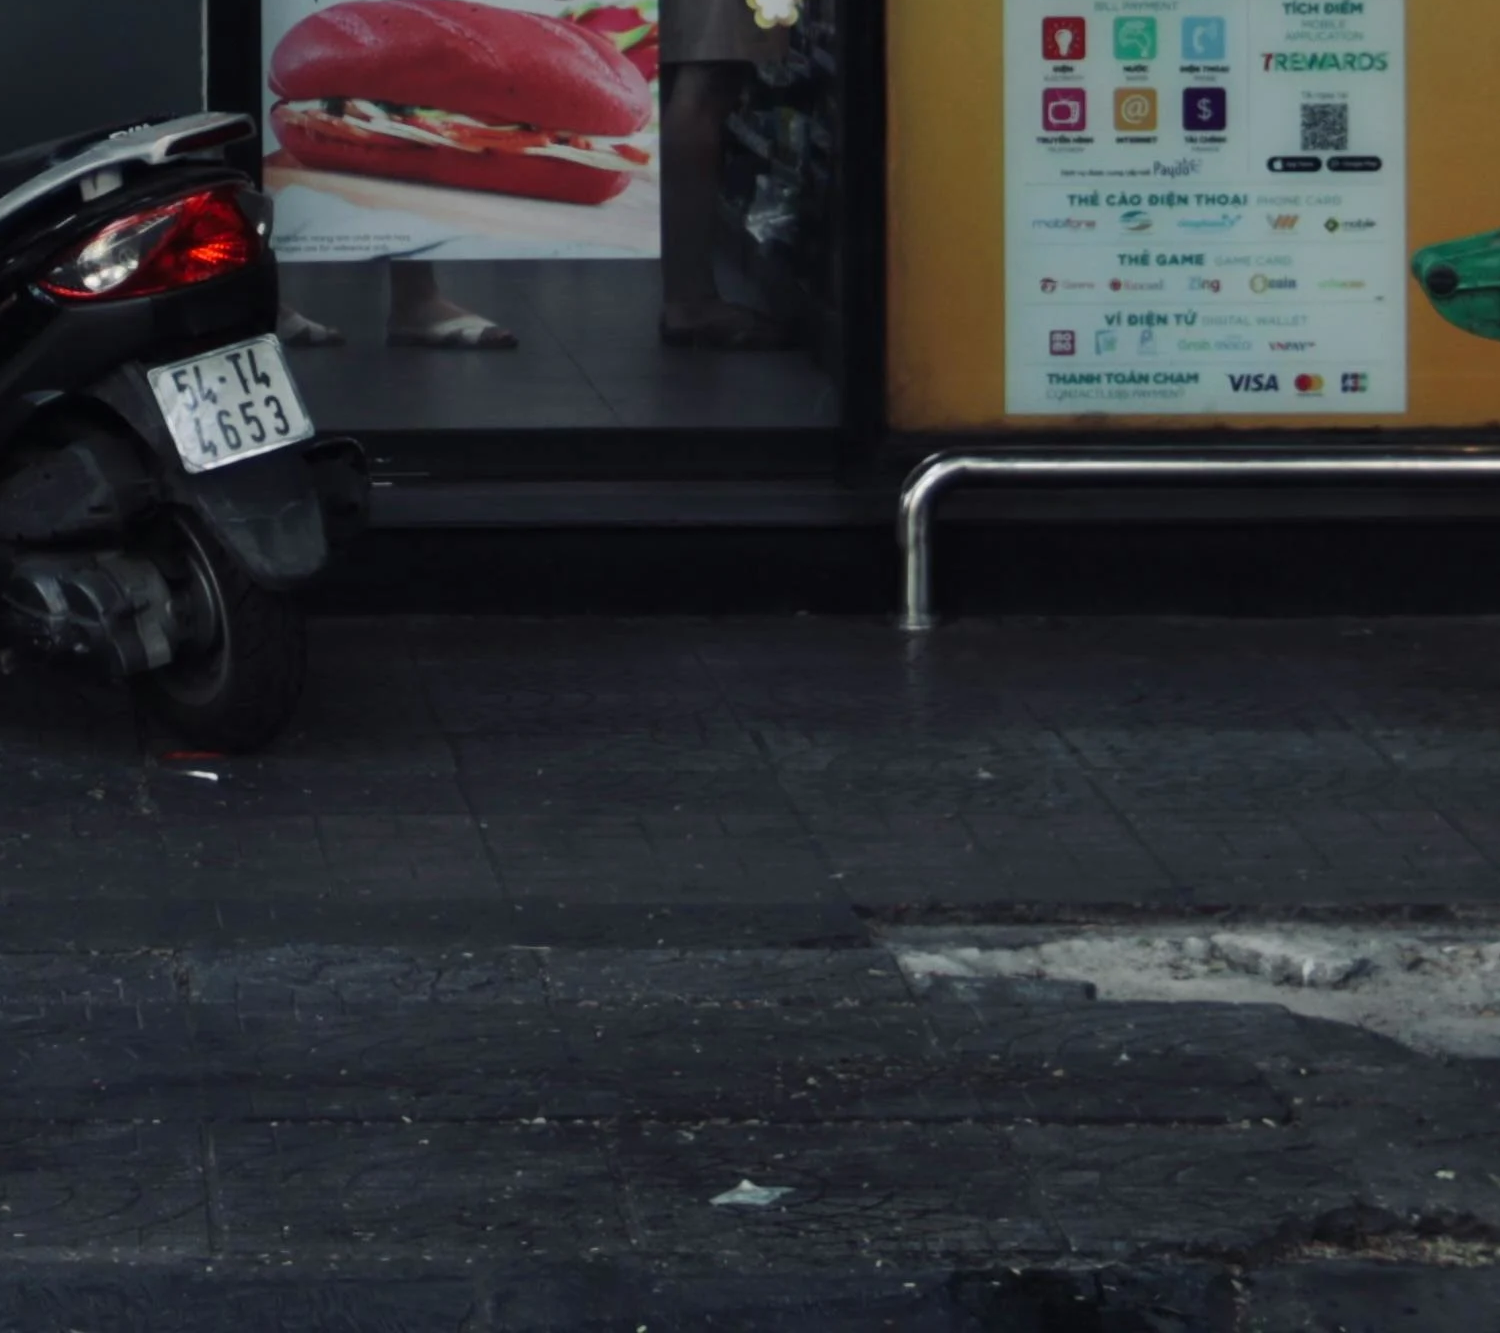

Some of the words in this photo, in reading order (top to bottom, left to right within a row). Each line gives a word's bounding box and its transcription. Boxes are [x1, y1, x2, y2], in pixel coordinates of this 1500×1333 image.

[1282, 0, 1320, 15] TÍCH
[1032, 217, 1096, 230] mobifone
[1228, 373, 1280, 392] VISA
[194, 395, 290, 457] 4653
